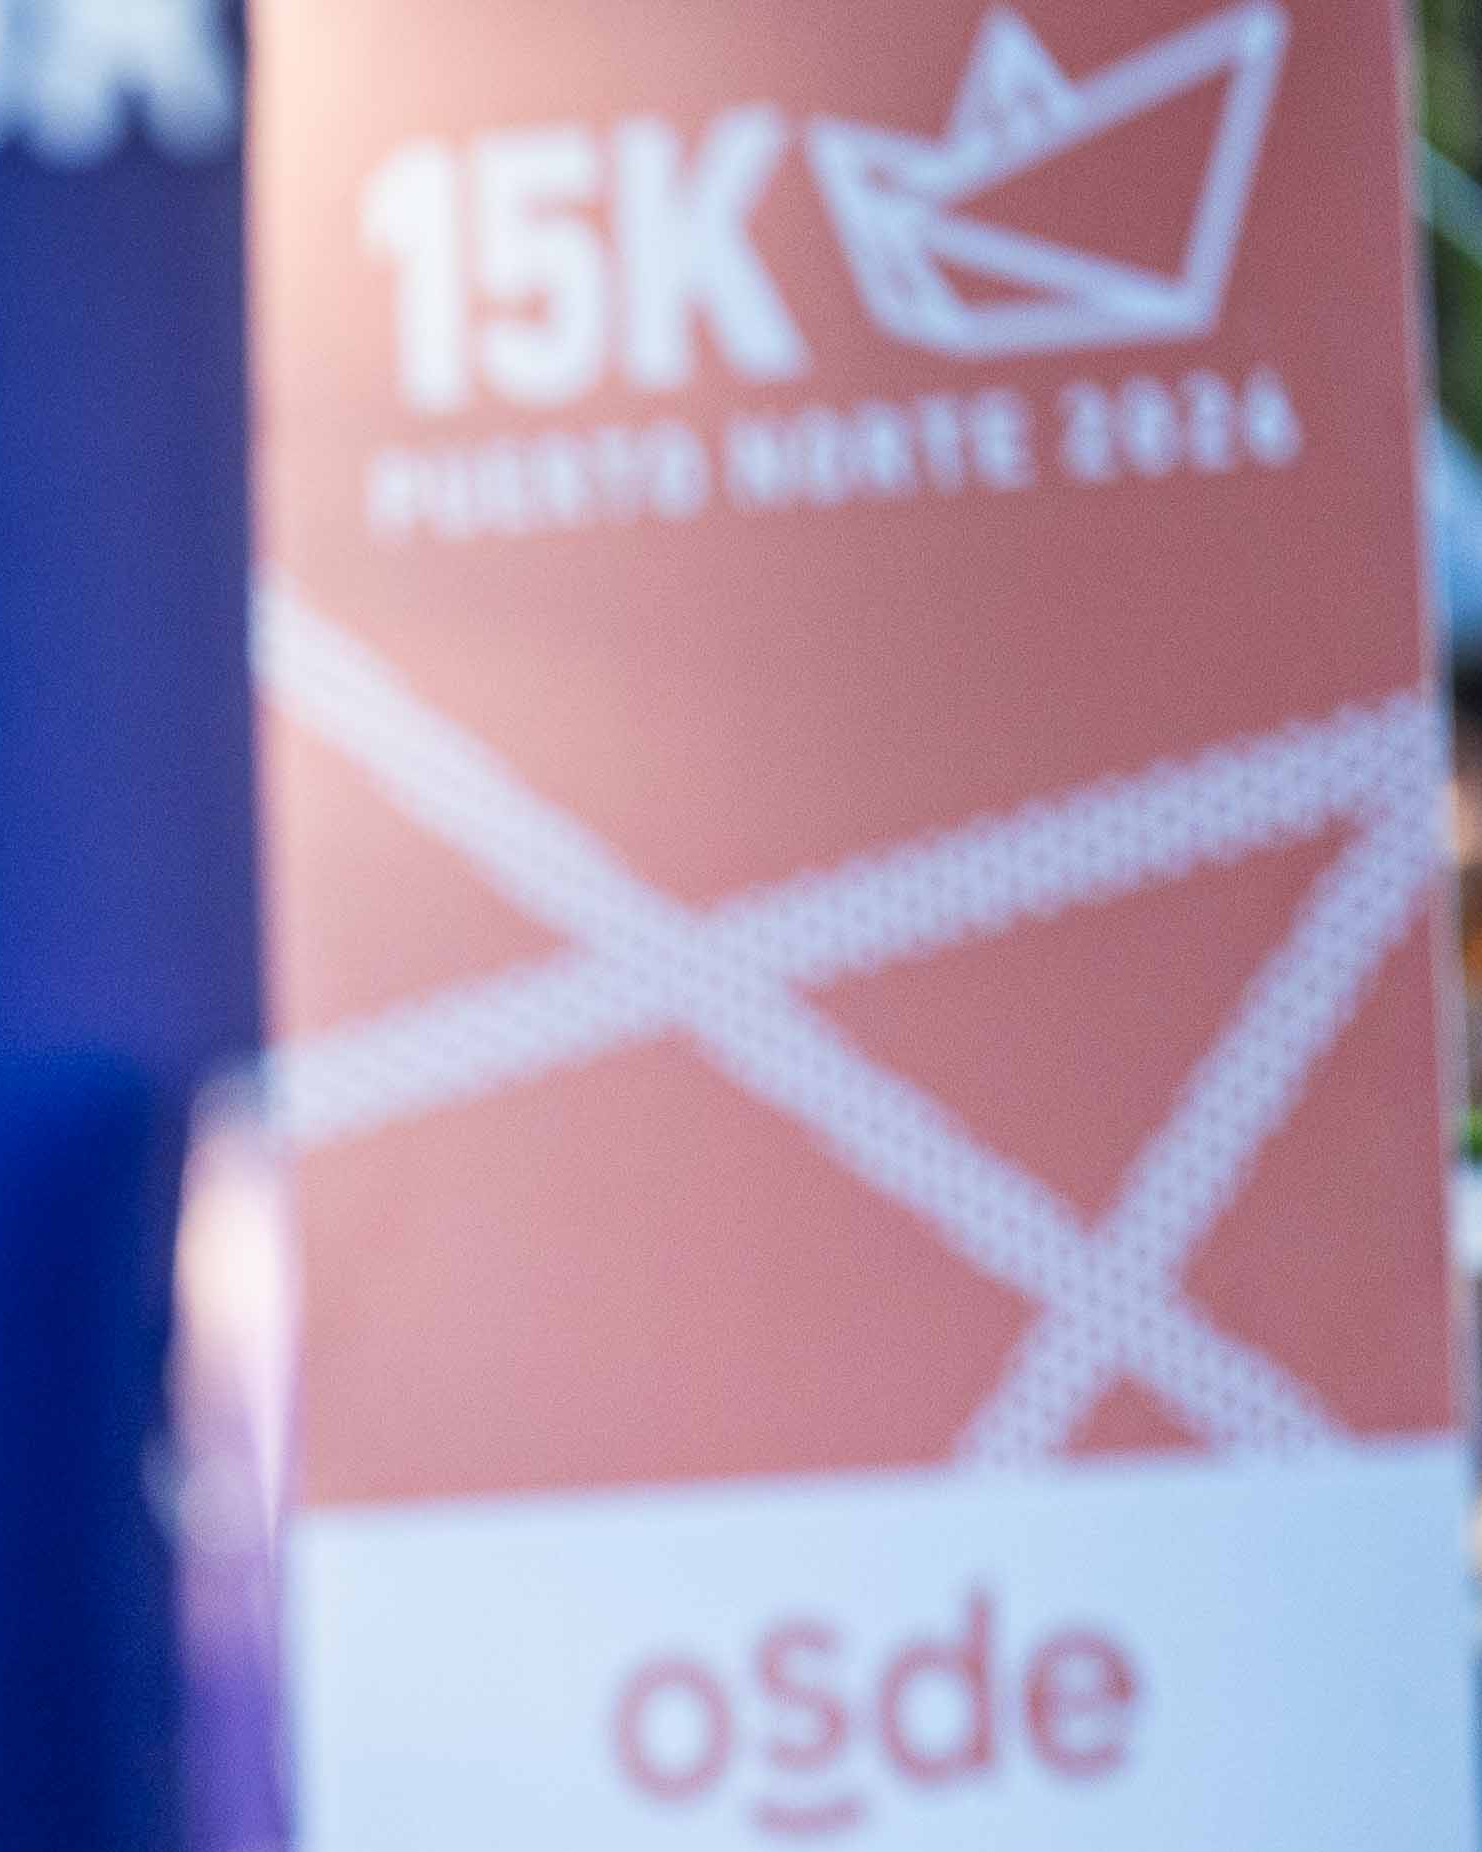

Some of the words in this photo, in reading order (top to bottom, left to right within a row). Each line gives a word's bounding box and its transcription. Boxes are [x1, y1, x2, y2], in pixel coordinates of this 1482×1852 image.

[363, 102, 809, 411] 15K
[367, 421, 709, 539] PUERTO
[726, 389, 1033, 509] NORTE
[615, 1576, 1137, 1840] osde
